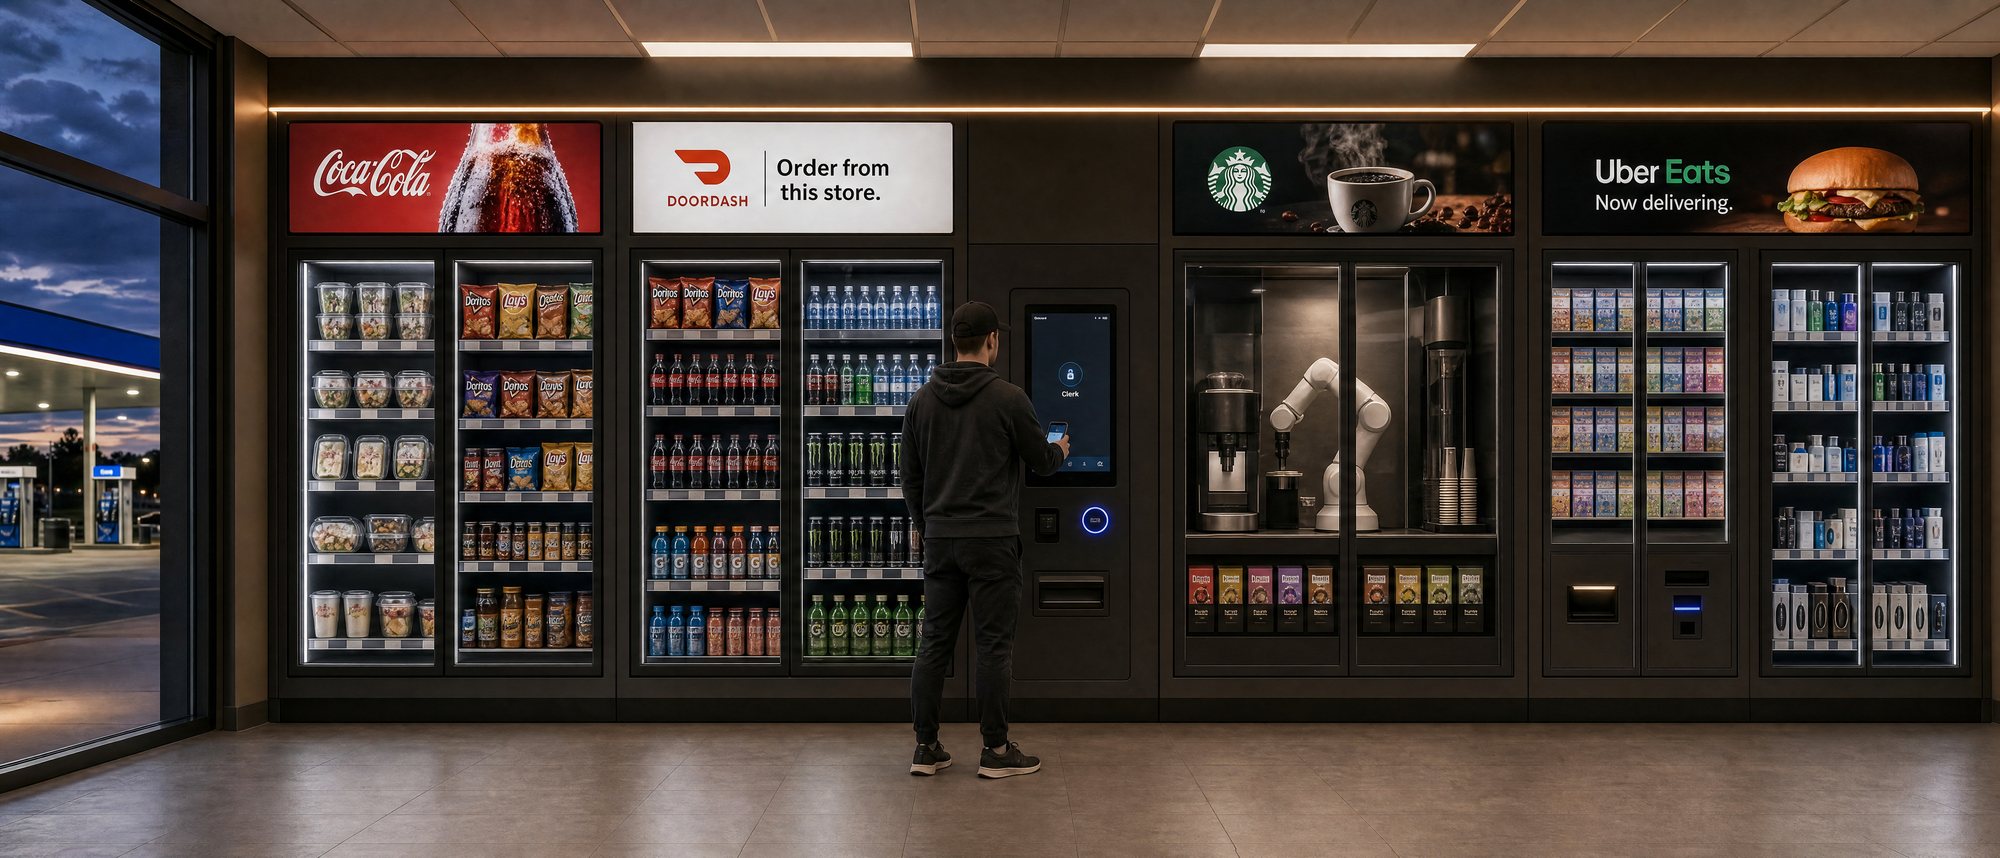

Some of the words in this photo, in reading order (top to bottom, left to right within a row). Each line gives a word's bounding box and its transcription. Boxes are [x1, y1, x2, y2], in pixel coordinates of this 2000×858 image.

[313, 149, 437, 197] Coca-Cola
[776, 158, 838, 177] Order
[842, 158, 889, 177] from
[1595, 158, 1660, 185] Uber
[1666, 158, 1731, 185] Eats
[780, 182, 819, 201] this
[823, 183, 881, 201] store.
[667, 195, 749, 207] DOORDASH
[1595, 194, 1638, 212] Now
[1642, 193, 1733, 215] delivering.
[652, 287, 679, 299] Doritos
[684, 287, 710, 299] Doritos
[717, 287, 744, 300] Doritos
[465, 295, 492, 307] Doritos
[465, 379, 493, 392] Doritos
[654, 557, 664, 569] G
[674, 557, 684, 569] G
[694, 557, 704, 569] G
[713, 557, 723, 569] G
[732, 557, 742, 569] G
[750, 557, 760, 569] G
[768, 557, 778, 569] G
